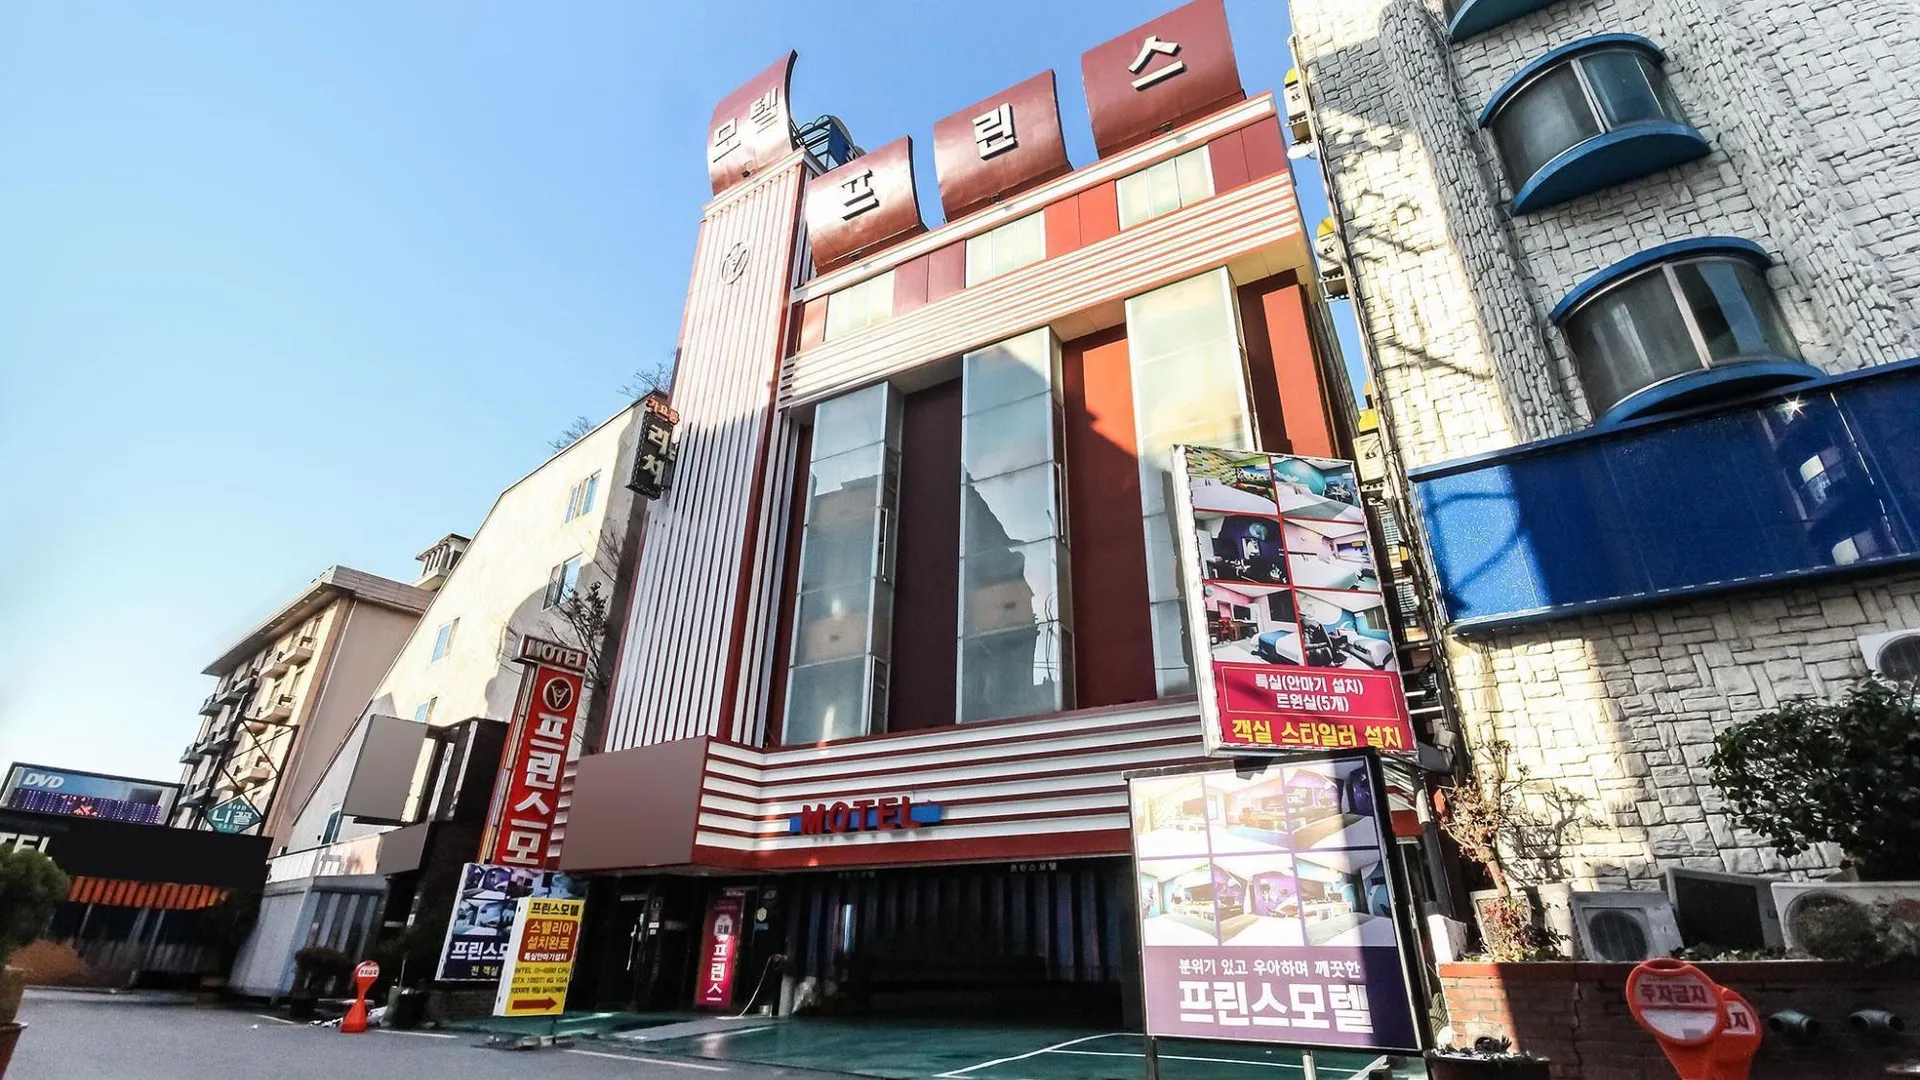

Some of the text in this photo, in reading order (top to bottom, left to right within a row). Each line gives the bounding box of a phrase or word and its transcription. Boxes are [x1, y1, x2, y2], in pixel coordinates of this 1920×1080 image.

[713, 86, 779, 164] 모텔
[526, 638, 586, 671] MOTEL
[1255, 673, 1364, 696] 특실(안마기 설치)
[1232, 719, 1403, 749] 객실 스타일러 설치
[22, 773, 65, 789] DVD
[501, 712, 569, 865] 프린스모
[800, 795, 921, 835] MOTEL
[530, 902, 580, 916] 프린스모텔
[527, 936, 570, 950] 설치완료
[706, 943, 728, 1001] 프린스
[1178, 958, 1361, 979] 분위기 있고 우아하며 깨끗한
[1177, 980, 1374, 1034] 프린스모텔
[1639, 984, 1708, 1004] 주차금지
